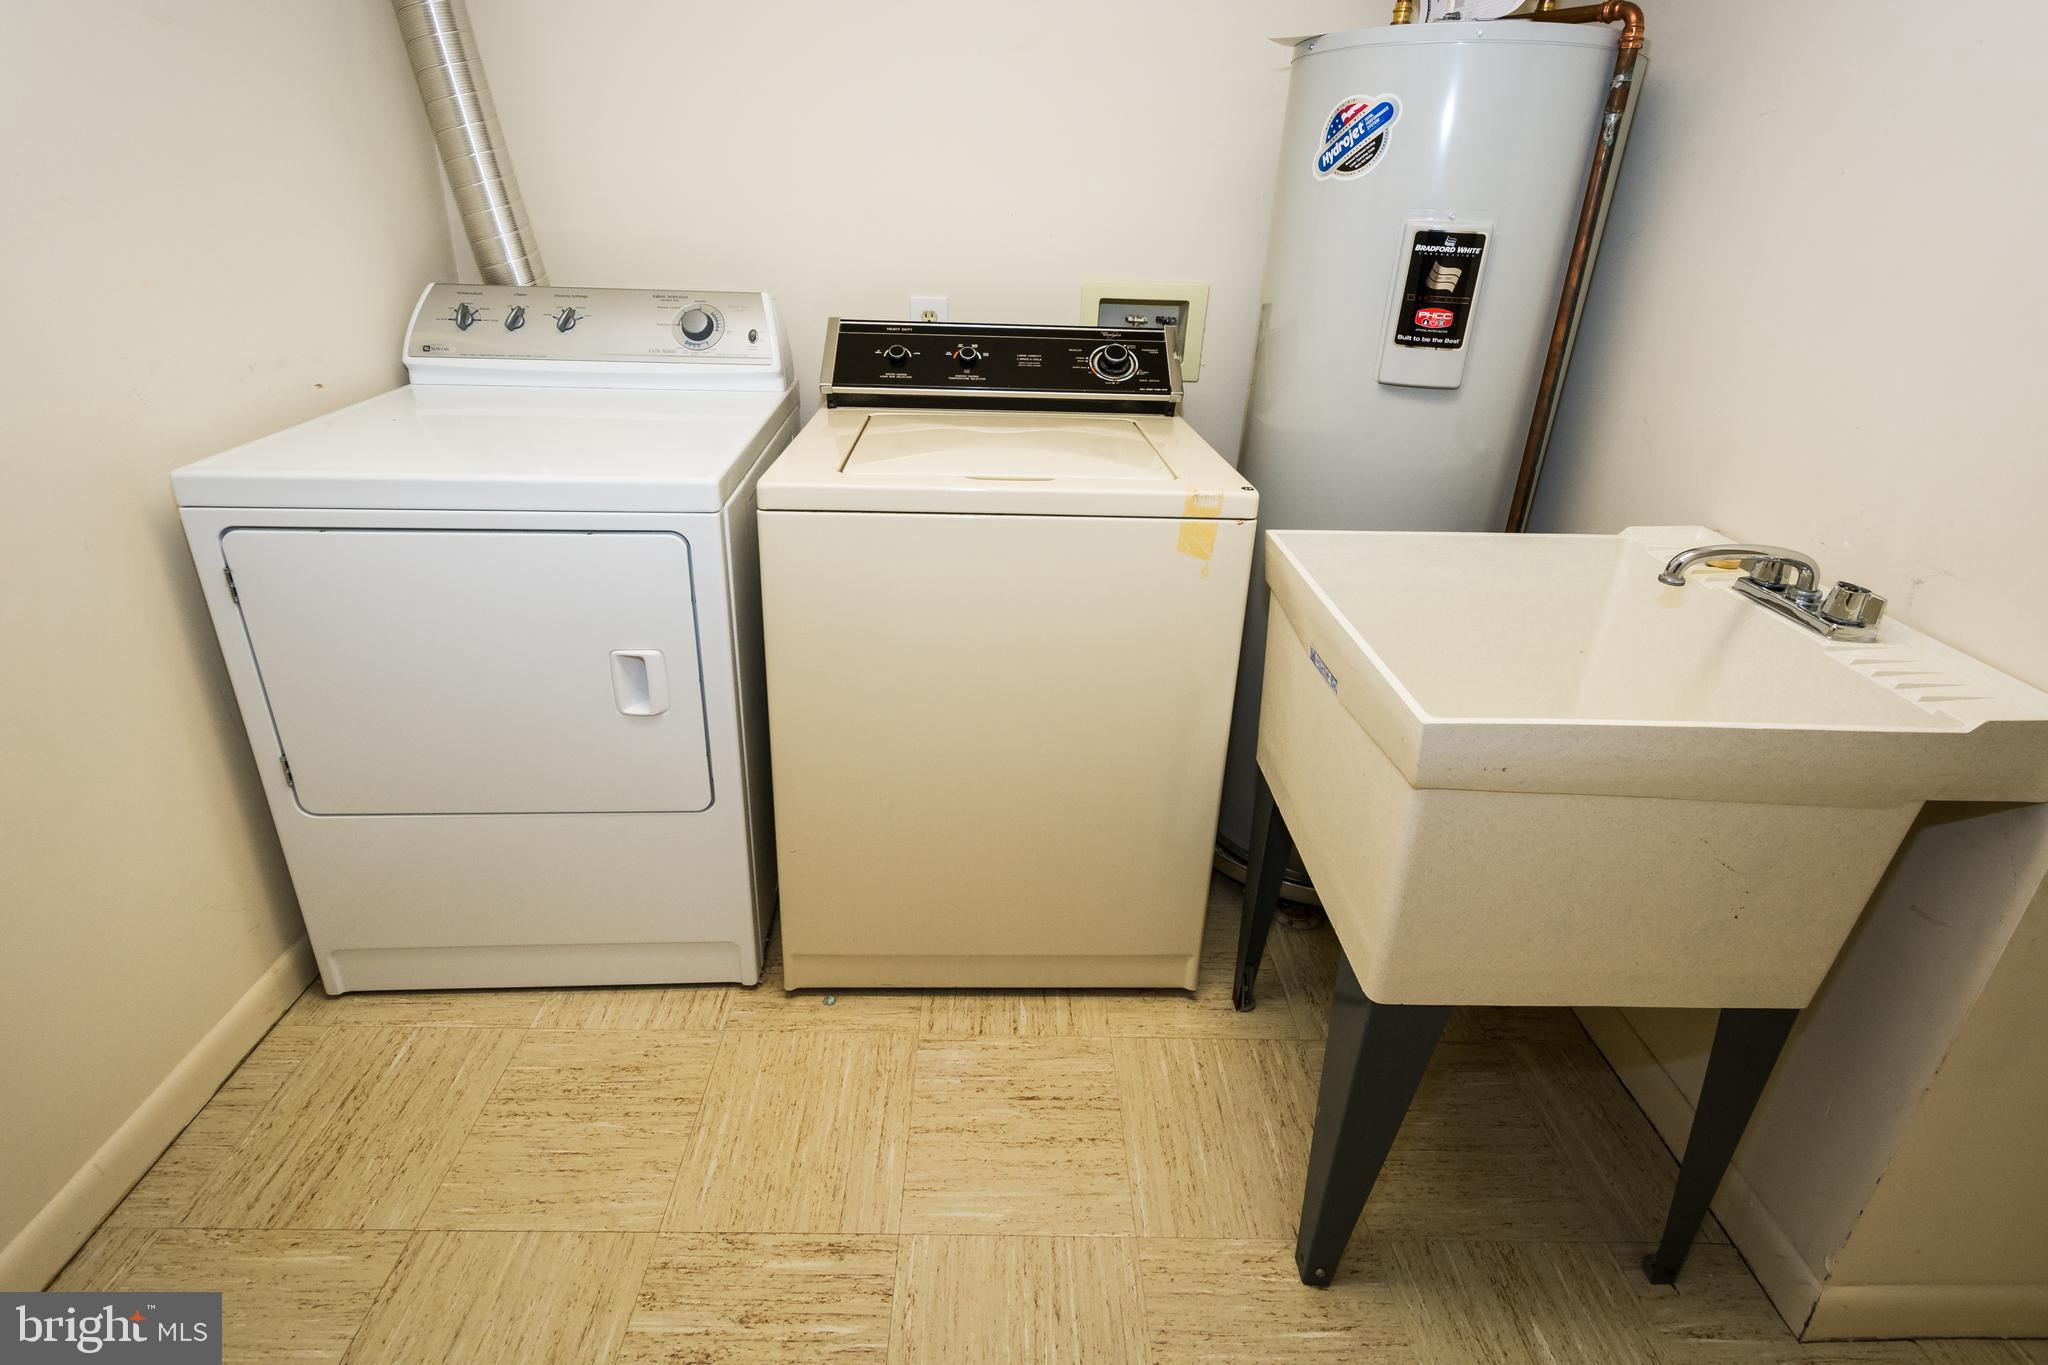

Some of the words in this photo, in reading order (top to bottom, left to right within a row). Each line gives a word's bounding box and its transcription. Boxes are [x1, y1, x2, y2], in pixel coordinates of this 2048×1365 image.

[1322, 121, 1365, 167] Hydrojet
[1415, 244, 1456, 253] BRADFORD
[1457, 246, 1482, 255] WHITE
[1418, 311, 1452, 320] PHCC
